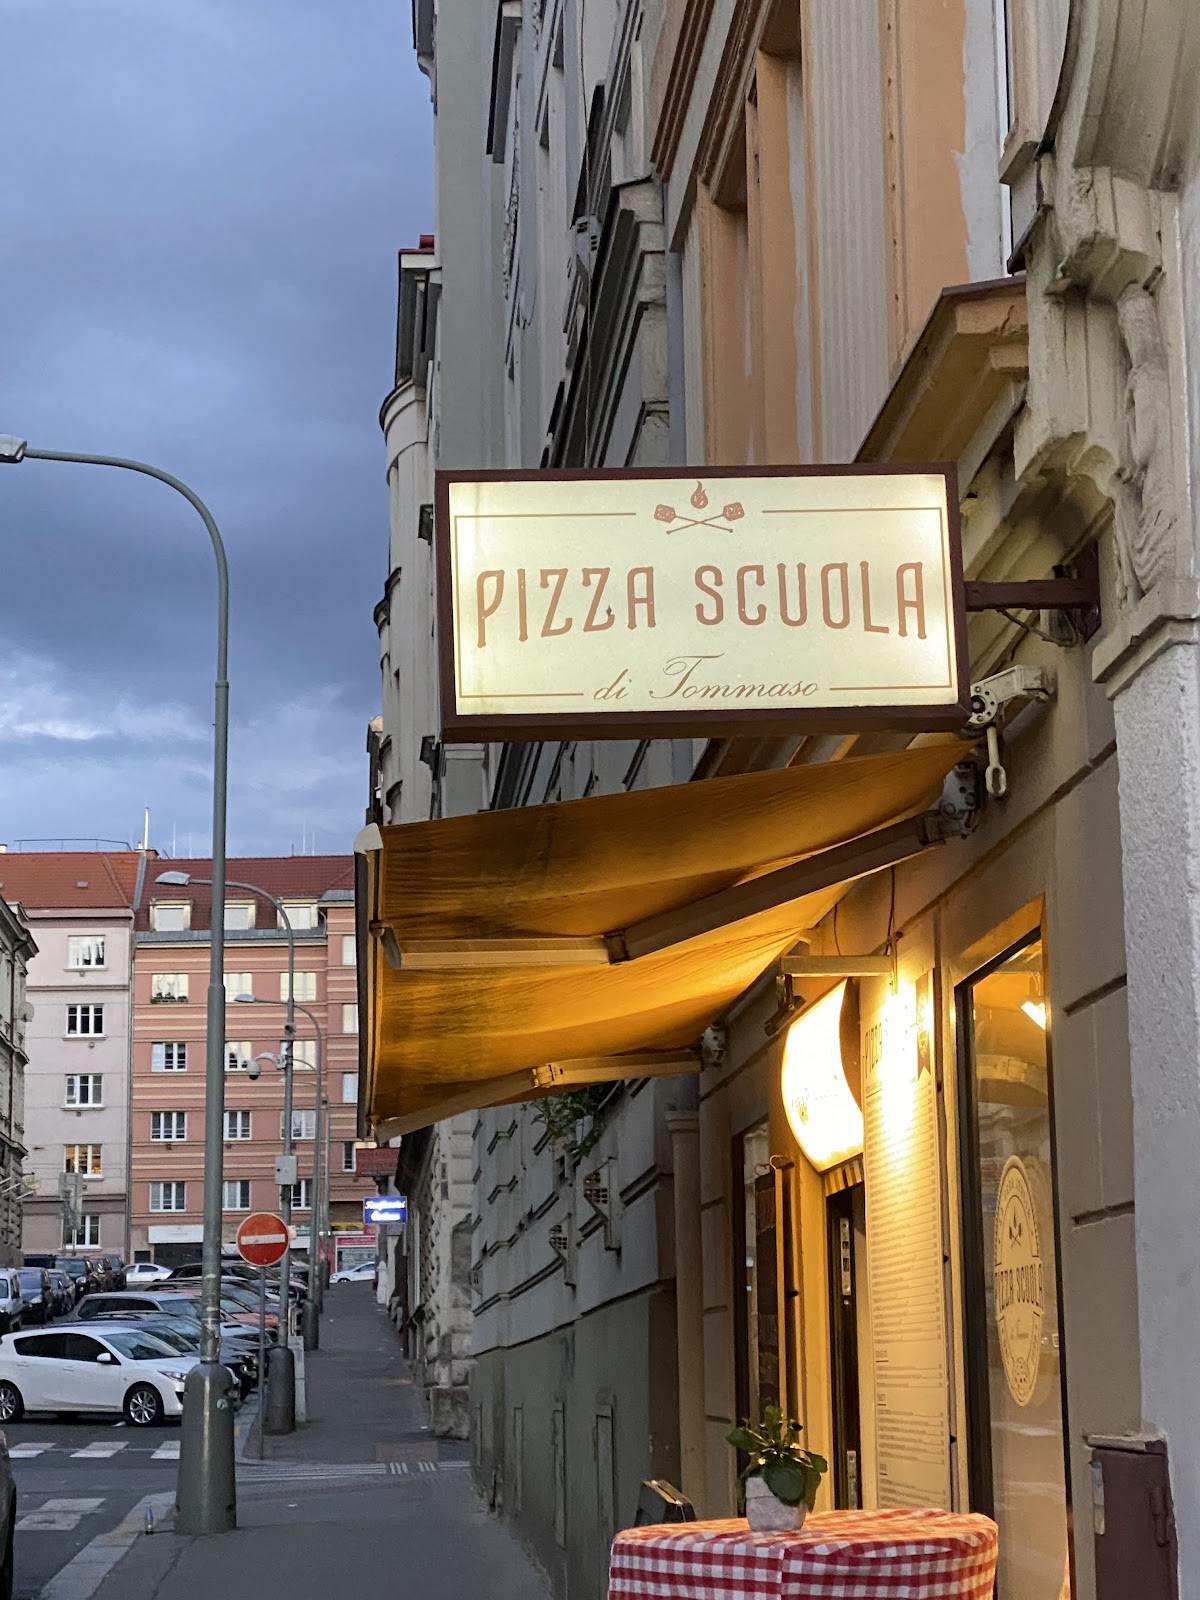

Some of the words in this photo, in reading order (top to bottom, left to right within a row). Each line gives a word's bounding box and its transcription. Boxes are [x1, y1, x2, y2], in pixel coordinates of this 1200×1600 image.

[476, 565, 657, 648] PIZZA
[694, 561, 929, 640] SCUOLA
[593, 668, 632, 701] di
[649, 652, 820, 700] Tommaso
[1016, 1263, 1044, 1310] SCUOLA
